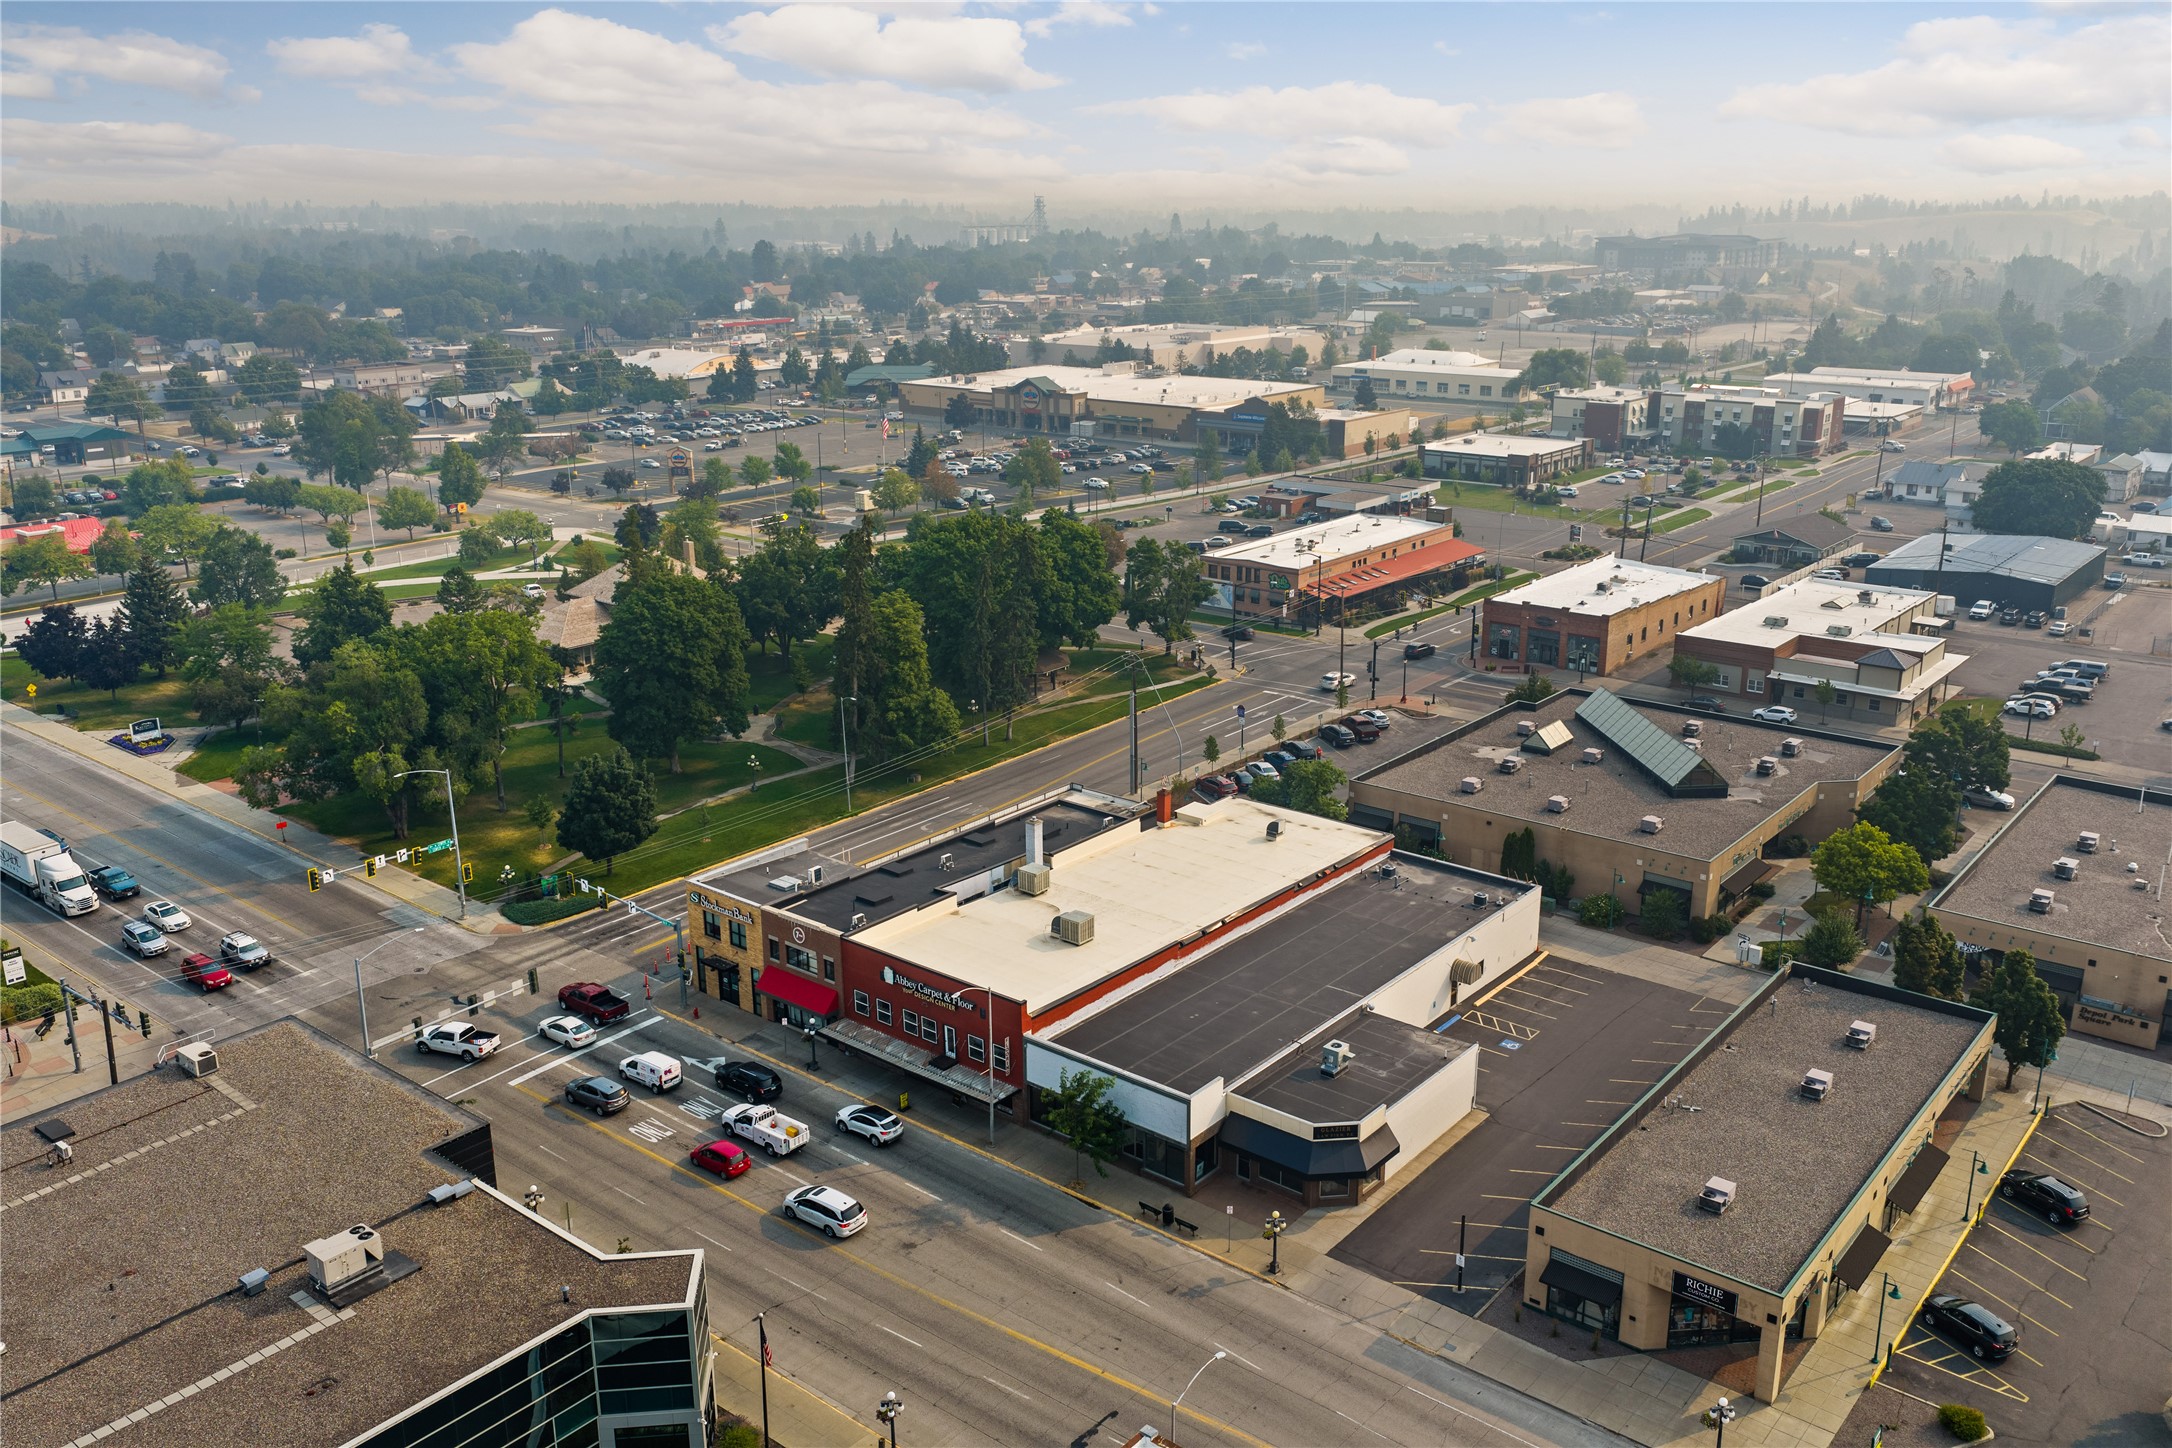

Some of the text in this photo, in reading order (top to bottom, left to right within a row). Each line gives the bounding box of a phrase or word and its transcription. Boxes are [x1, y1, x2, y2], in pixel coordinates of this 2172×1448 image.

[894, 974, 974, 1011] Abbey Carpet & Floor
[914, 991, 935, 1004] DESIGN
[934, 998, 956, 1012] CENTER
[2077, 1013, 2112, 1026] Square
[2079, 1006, 2136, 1026] Depot Park
[678, 1095, 725, 1120] ONLY
[628, 1117, 677, 1143] ONLY
[1686, 1278, 1724, 1299] RICHIE
[1687, 1287, 1710, 1299] CUSTOM
